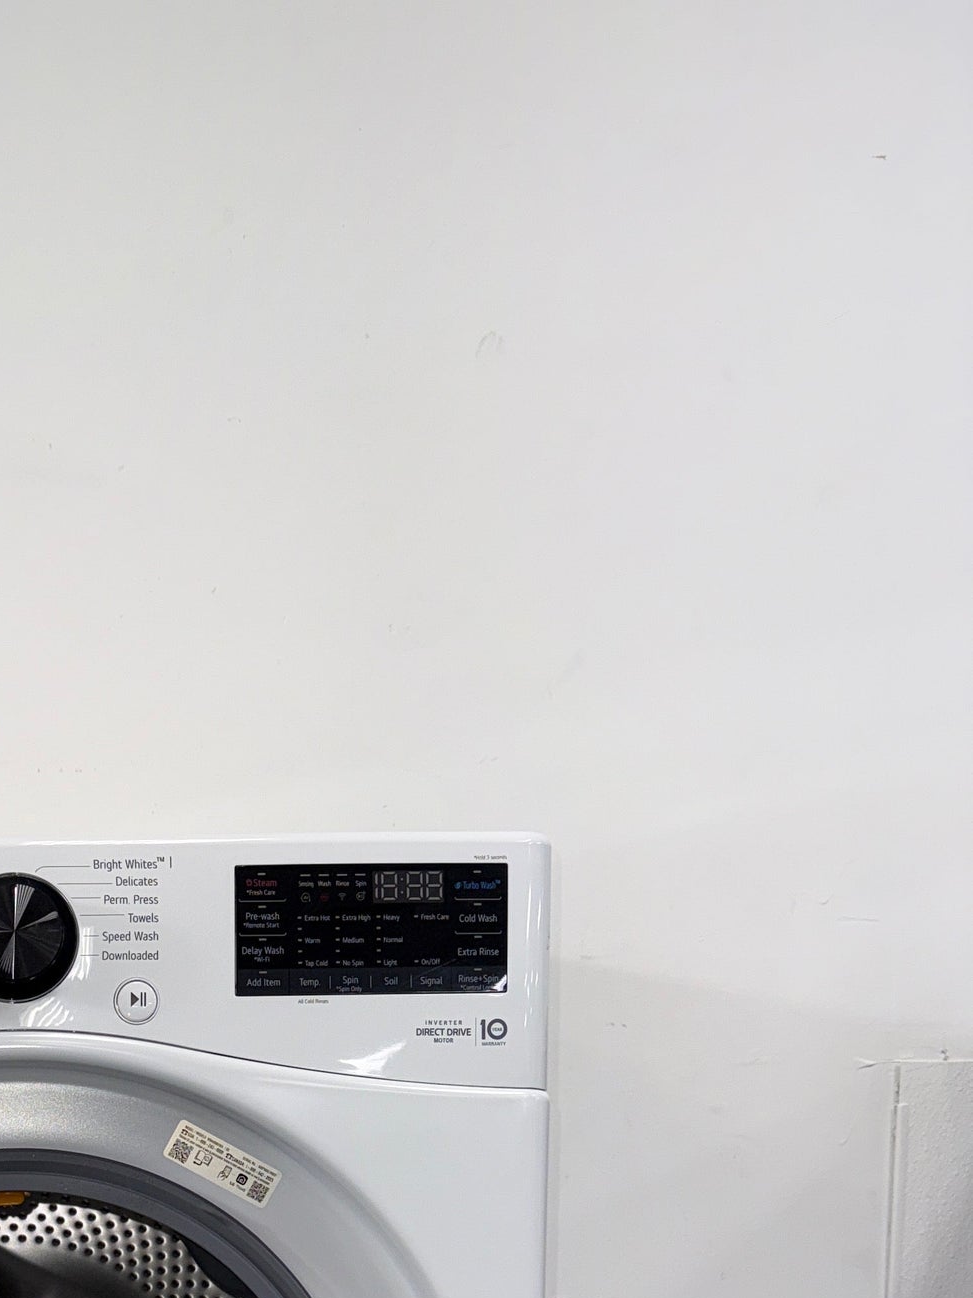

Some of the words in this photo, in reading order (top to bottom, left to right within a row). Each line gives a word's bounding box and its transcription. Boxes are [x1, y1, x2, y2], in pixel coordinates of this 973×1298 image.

[93, 859, 122, 872] Bright
[115, 876, 158, 887] Delicates
[253, 879, 277, 887] Steam
[355, 880, 367, 888] Spin
[103, 894, 130, 905] Perm.
[133, 894, 159, 905] Press
[128, 912, 159, 923] Towels
[245, 912, 280, 921] Pre-wash
[358, 914, 372, 922] High
[383, 914, 400, 922] Heavy
[459, 914, 476, 923] Cold
[478, 914, 498, 923] Wash
[102, 931, 131, 944] Speed
[134, 931, 159, 941] Wash
[102, 950, 159, 961] Downloaded
[241, 946, 262, 957] Delay
[264, 946, 285, 955] Wash
[458, 947, 477, 956] Extra
[479, 947, 500, 956] Rinse
[299, 977, 321, 988] Temp.
[342, 975, 359, 985] Spin
[384, 976, 398, 985] Soil
[420, 976, 443, 987] Signal
[416, 1028, 445, 1036] DIRECT
[447, 1028, 472, 1036] DRIVE
[480, 1019, 507, 1040] 10
